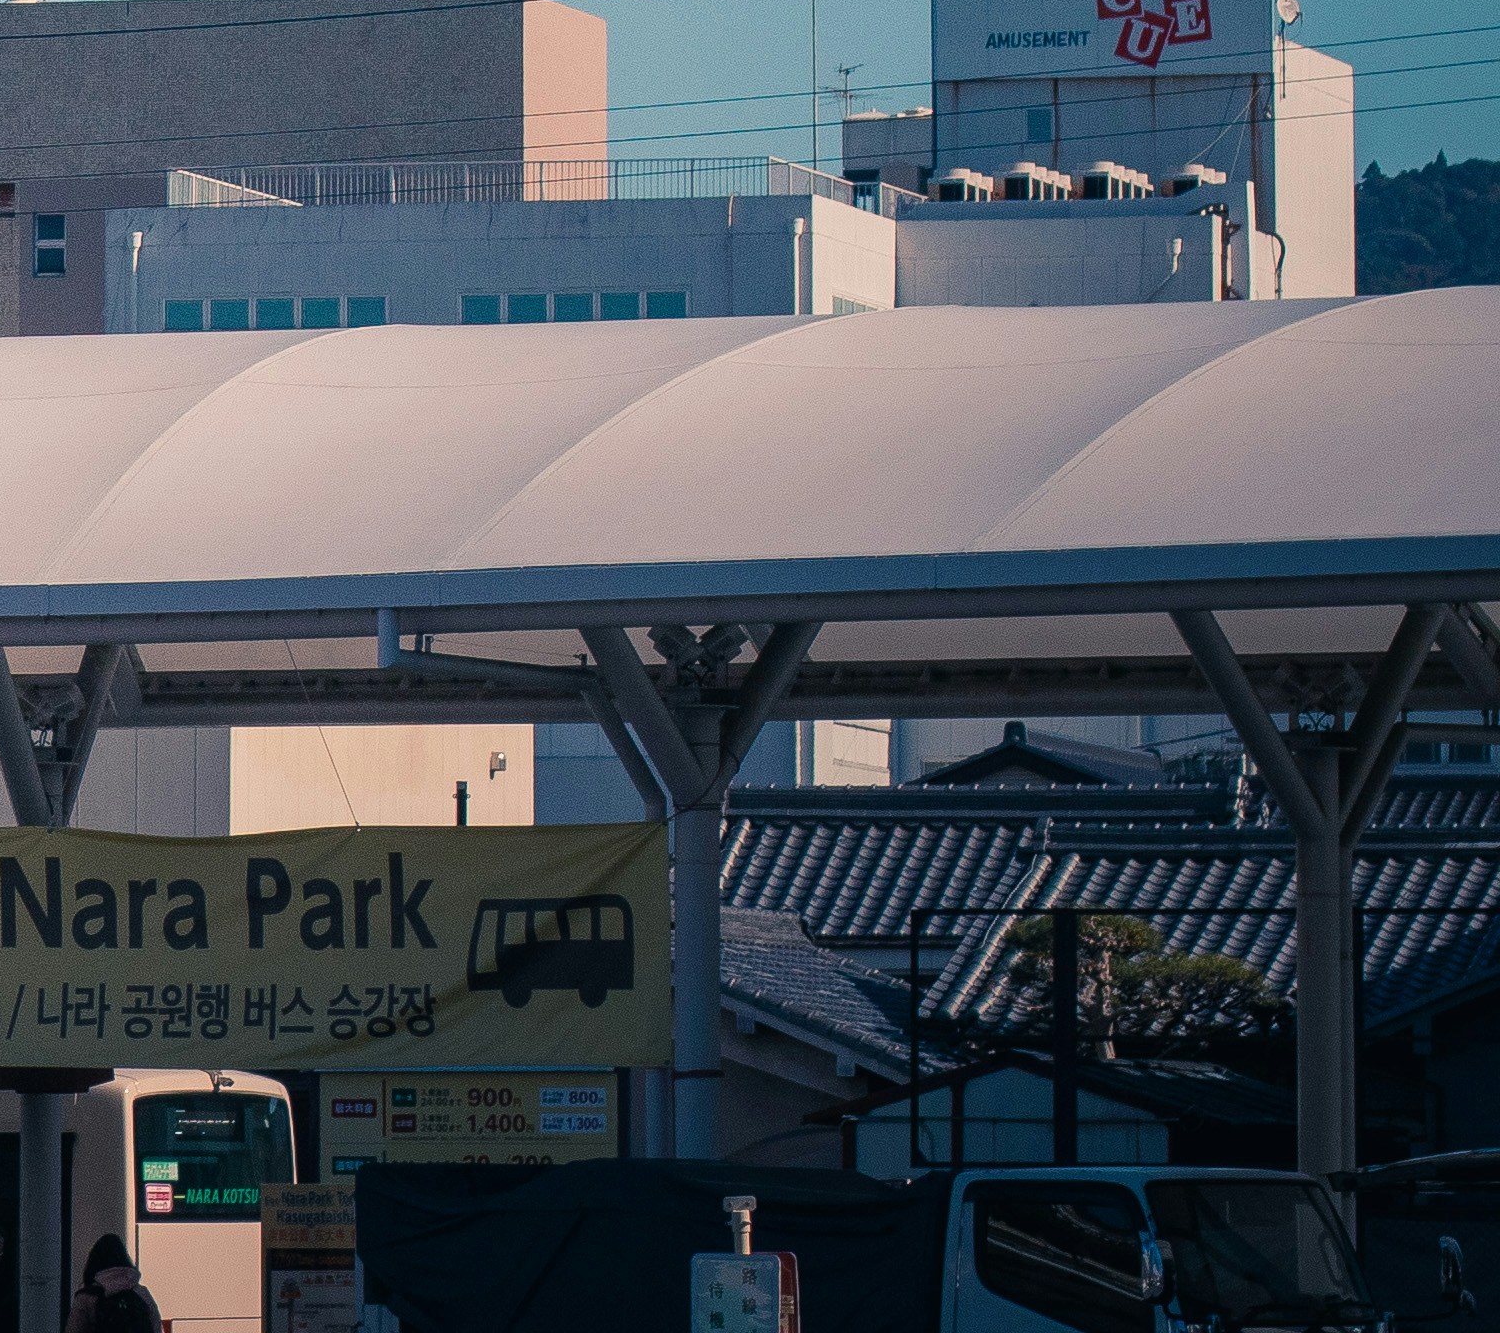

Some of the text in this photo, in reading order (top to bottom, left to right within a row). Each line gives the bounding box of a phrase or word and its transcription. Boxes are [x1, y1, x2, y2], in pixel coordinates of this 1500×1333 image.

[986, 30, 1089, 50] AMUSEMENT
[0, 856, 209, 951] Nara
[245, 851, 439, 952] Park
[38, 984, 110, 1039] 나라
[122, 983, 231, 1040] 공원행
[243, 985, 316, 1041] 버스
[327, 982, 437, 1039] 승강장
[187, 1188, 219, 1204] NARA
[222, 1188, 259, 1204] KOTSU
